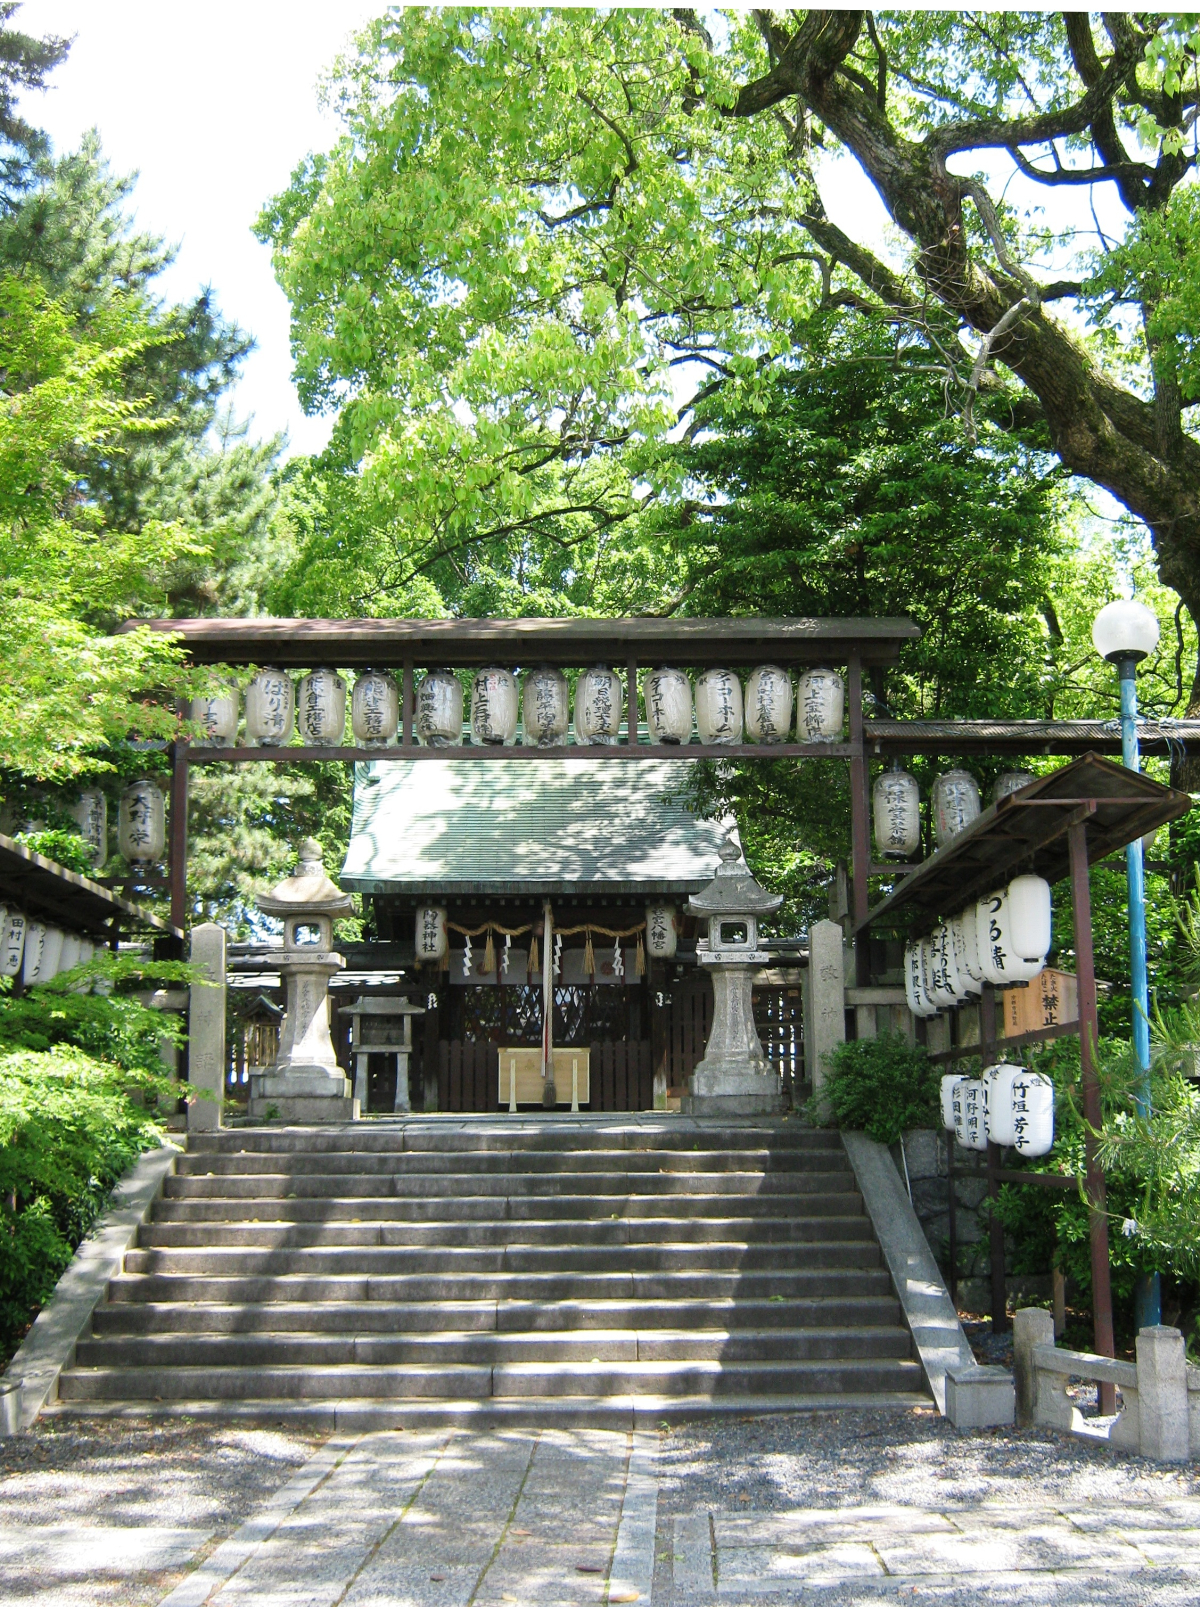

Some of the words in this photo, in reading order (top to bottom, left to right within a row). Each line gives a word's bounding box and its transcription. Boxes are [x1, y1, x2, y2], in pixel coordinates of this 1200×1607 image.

[264, 680, 285, 729] はり清
[422, 909, 438, 953] 陶器神社
[651, 908, 667, 949] 若宮八幡宮
[1042, 993, 1059, 1026] 禁止
[1012, 1081, 1030, 1149] 竹垣芳子
